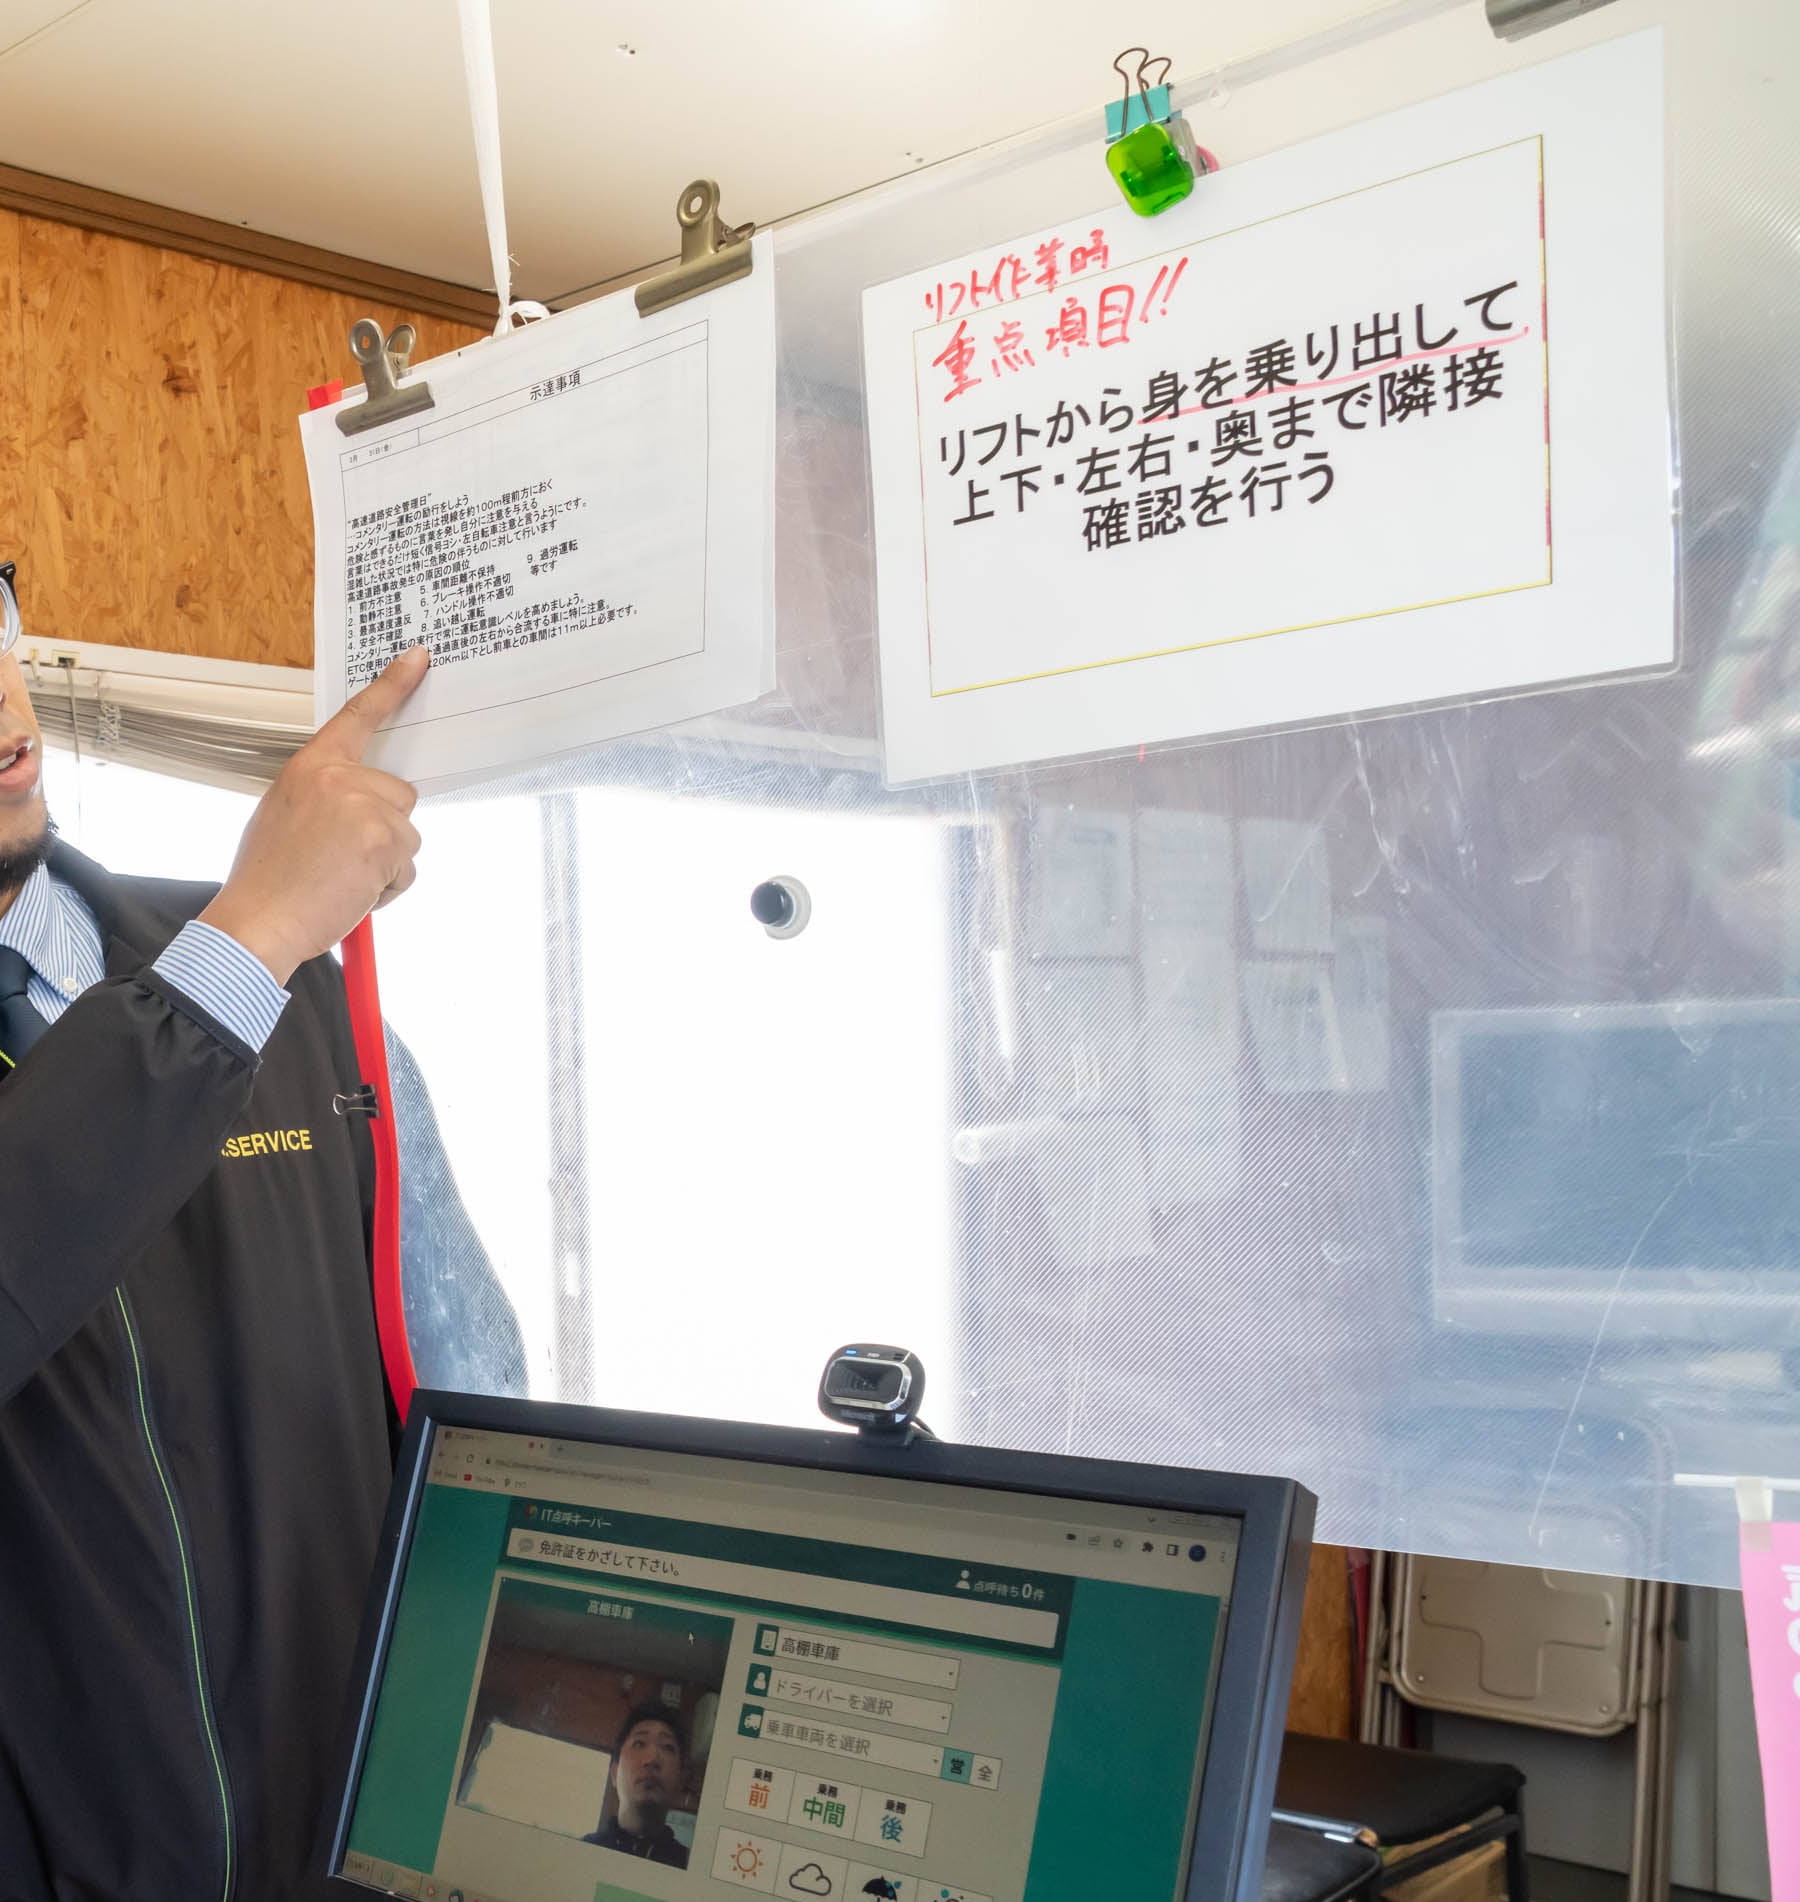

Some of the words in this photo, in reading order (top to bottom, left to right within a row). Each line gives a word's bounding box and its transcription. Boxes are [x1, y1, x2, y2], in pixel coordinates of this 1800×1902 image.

[925, 228, 1109, 322] リフト作業時
[529, 370, 582, 402] 示達事項
[938, 280, 1520, 478] リフトから身を乗り出して
[952, 346, 1504, 526] 上下・左右・奥まで隣接
[1083, 451, 1336, 552] 確認を行う
[539, 539, 579, 562] 過労運転
[347, 559, 470, 604] 高速道路事故発生の原因の順位
[432, 564, 496, 591] 車間距離不保持
[530, 560, 558, 576] 等です
[360, 591, 402, 612] 前方不注意
[432, 573, 511, 605] ブレーキ操作不適切
[436, 585, 515, 616] ハンドル操作不適切
[360, 603, 402, 624] 動静不注意
[360, 613, 412, 636] 最高速度違反
[433, 606, 486, 630] 追い越し運転
[360, 629, 403, 648] 安全不確認
[539, 1540, 680, 1577] 免許証をかざして下さい。
[781, 1636, 841, 1662] 高棚車庫
[776, 1678, 894, 1718] ドライバーを選択
[766, 1718, 871, 1757] 乗車車両を選択
[748, 1783, 771, 1810] 前
[802, 1796, 846, 1829] 中間
[880, 1813, 904, 1844] 後
